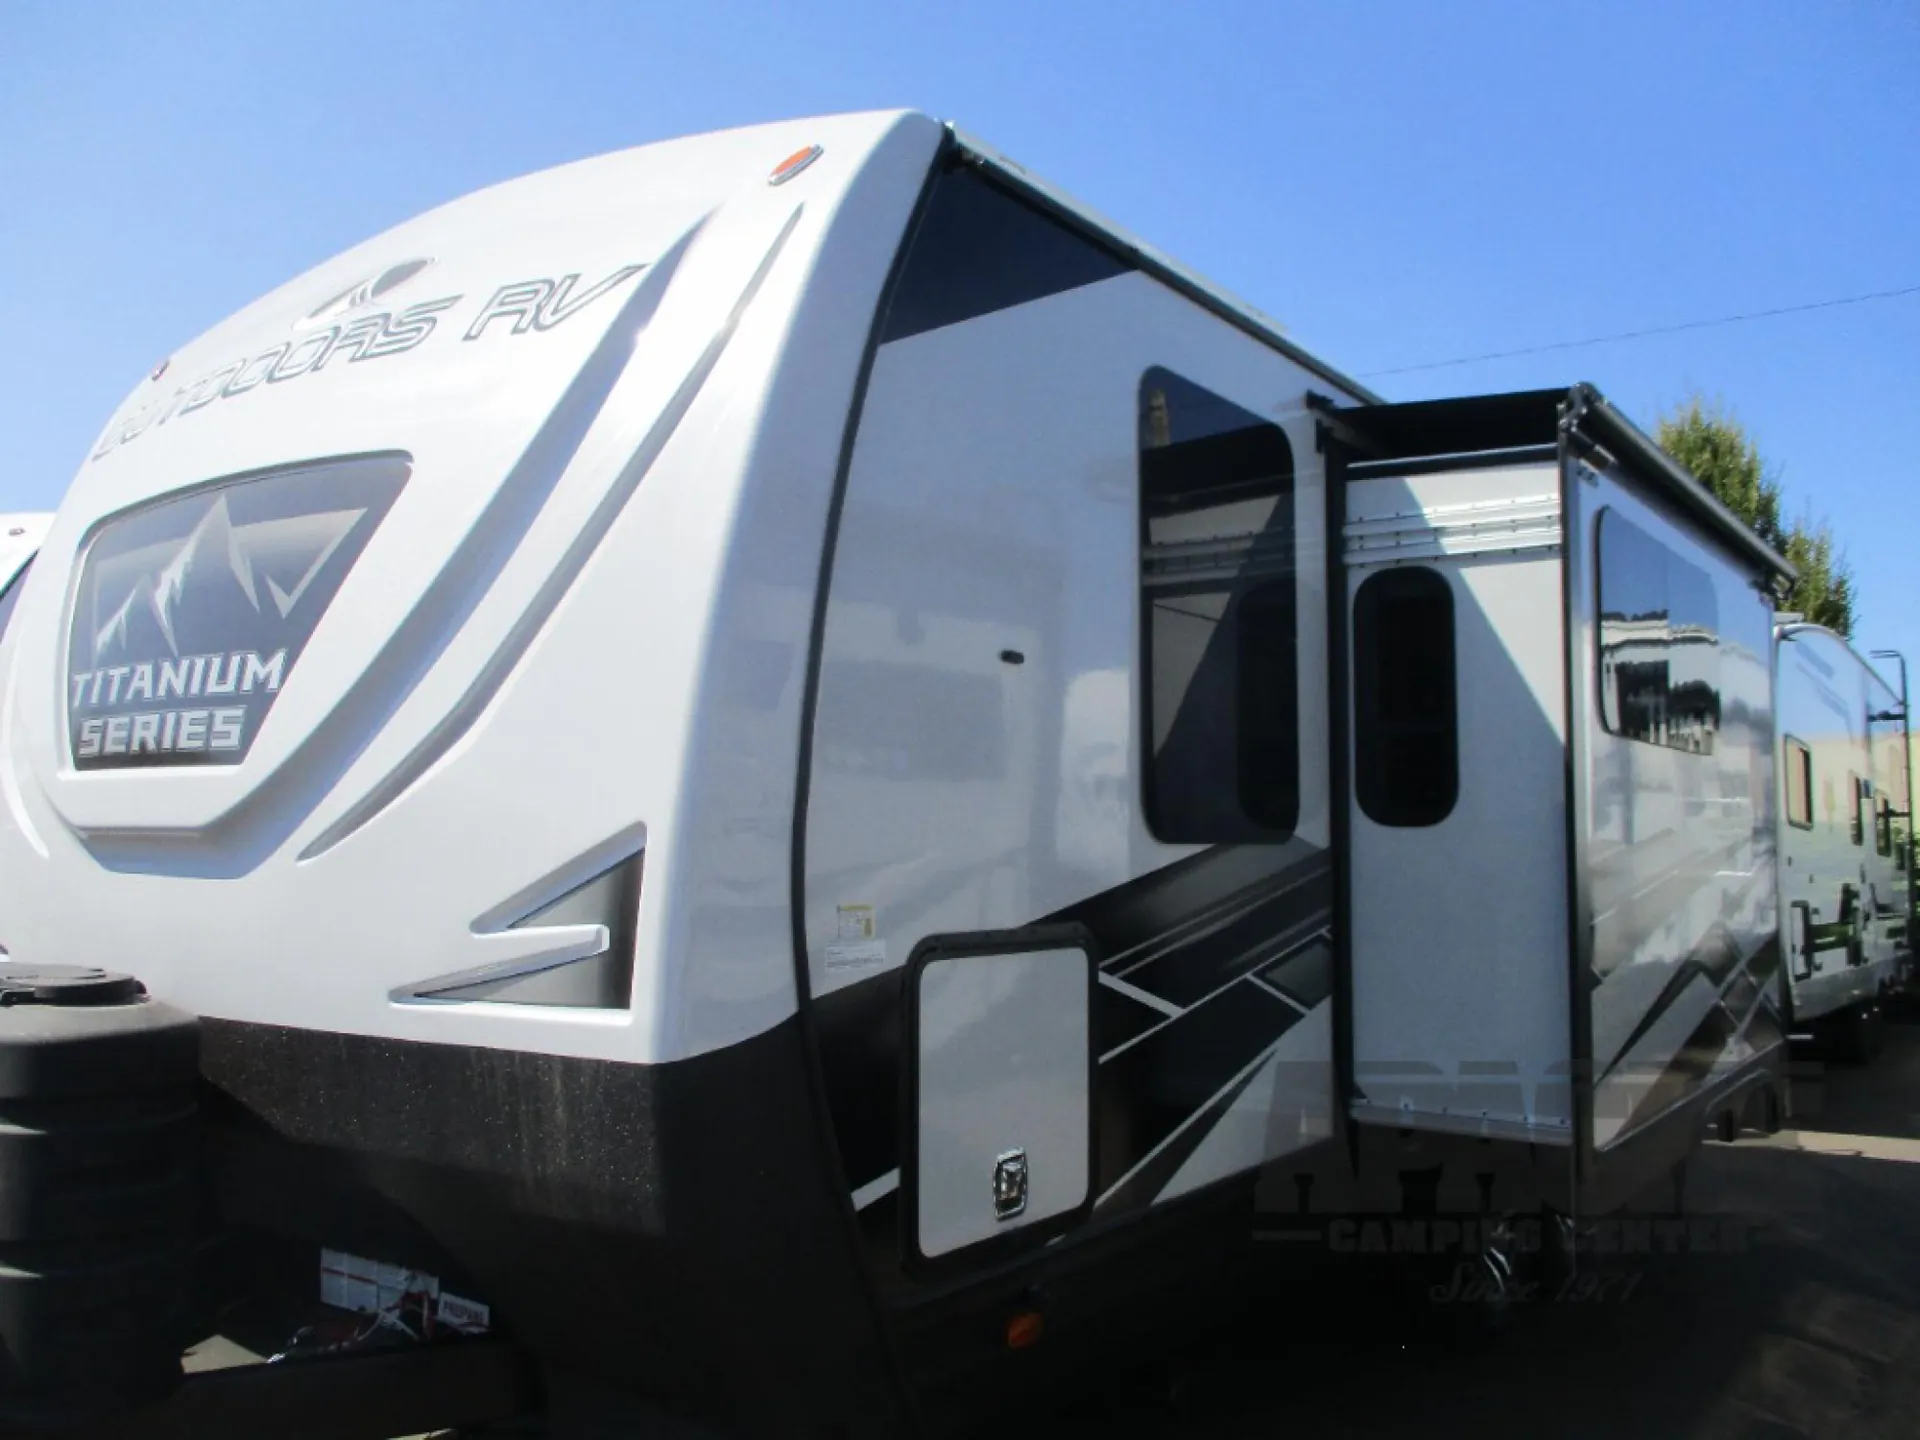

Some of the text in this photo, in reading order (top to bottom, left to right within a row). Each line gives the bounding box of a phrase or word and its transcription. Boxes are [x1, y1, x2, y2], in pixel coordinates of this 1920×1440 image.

[462, 263, 652, 343] RV
[72, 648, 288, 708] TITANIUM
[79, 705, 248, 758] SERIES
